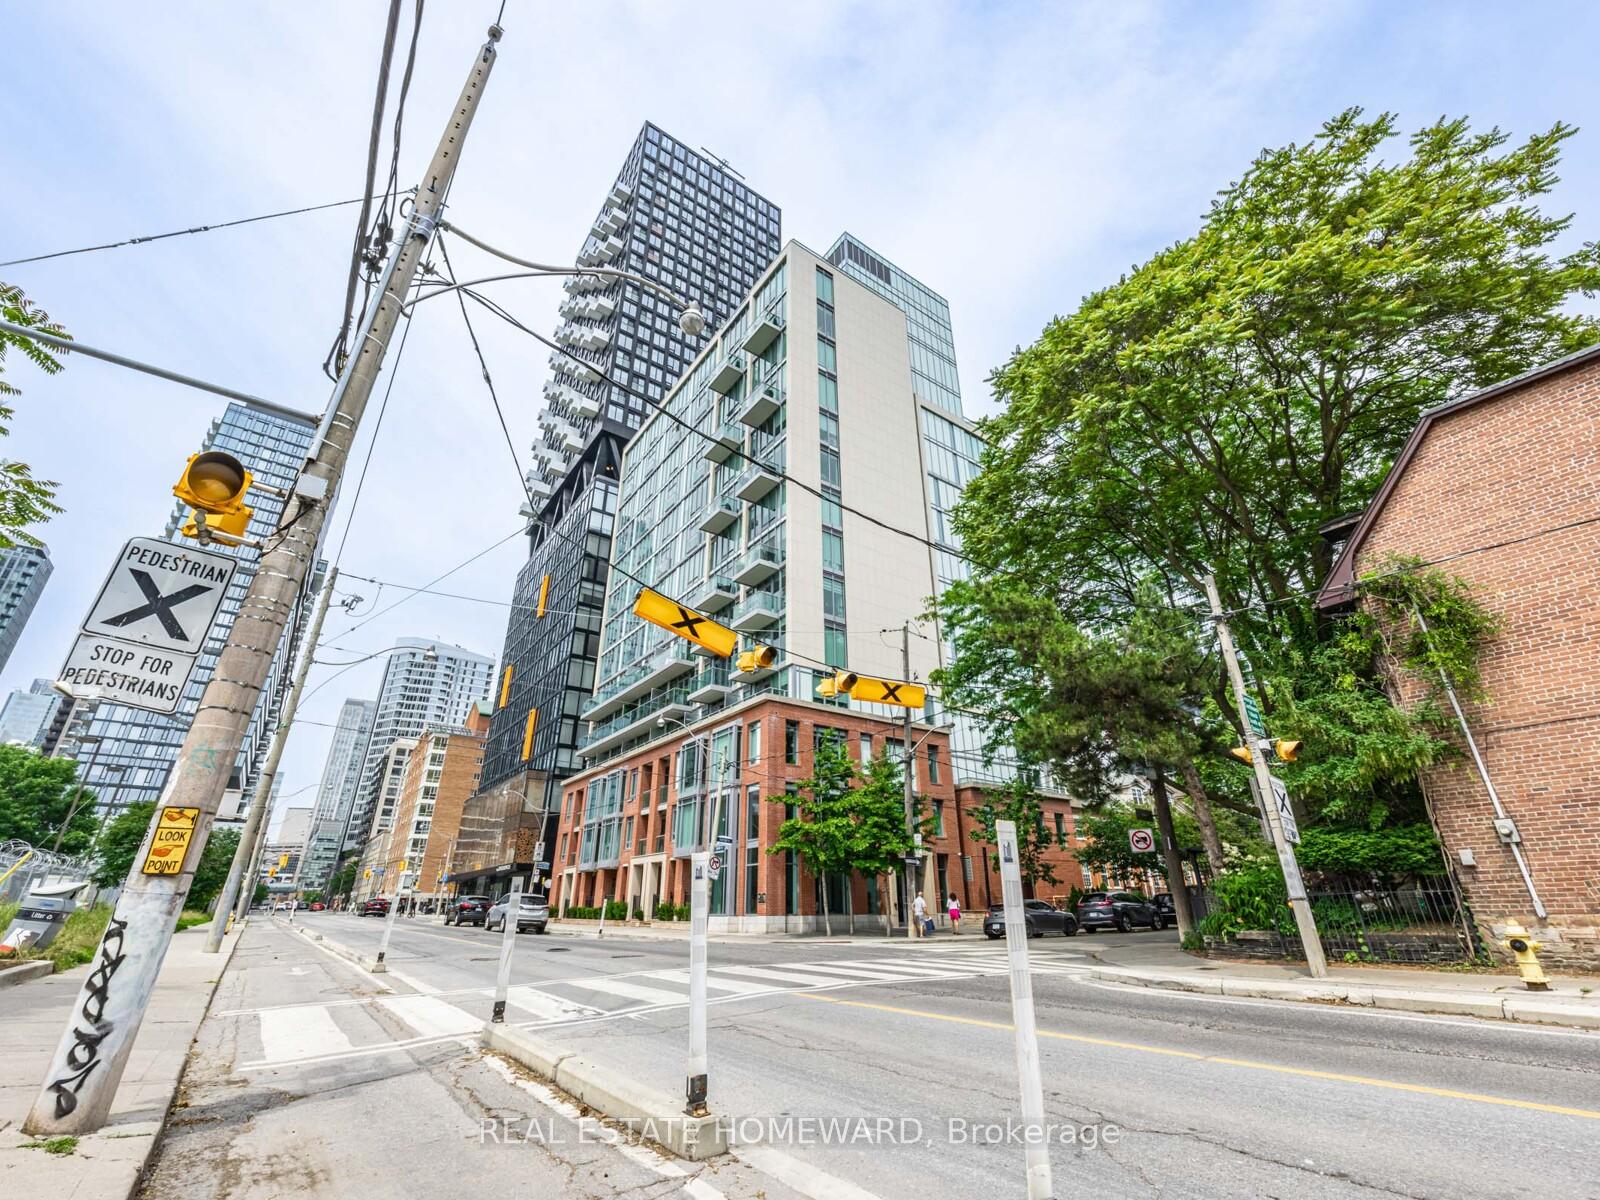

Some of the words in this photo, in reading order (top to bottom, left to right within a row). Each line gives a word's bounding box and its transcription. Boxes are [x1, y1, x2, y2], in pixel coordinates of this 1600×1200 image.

[126, 546, 228, 583] PEDESTRIAN
[90, 644, 135, 666] STOP
[140, 656, 173, 676] FOR
[63, 667, 179, 701] PEDESTRIANS
[158, 831, 187, 842] LOOK
[146, 860, 179, 871] POINT
[31, 911, 46, 919] Litter
